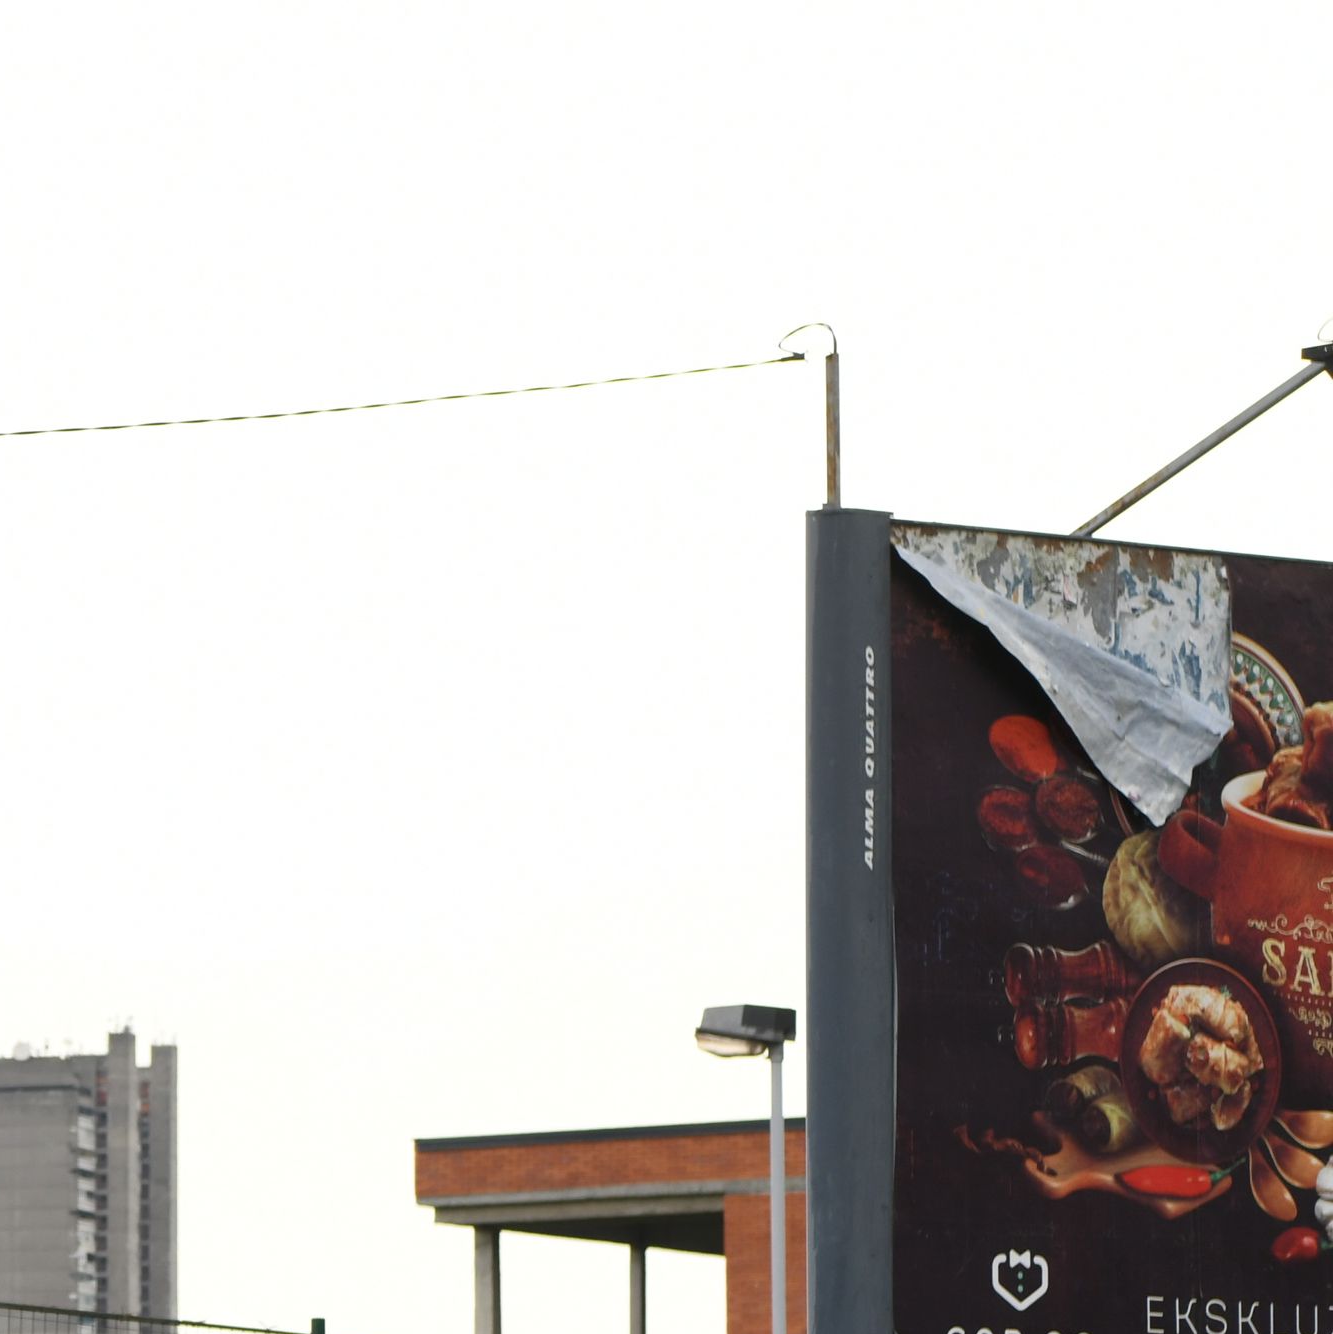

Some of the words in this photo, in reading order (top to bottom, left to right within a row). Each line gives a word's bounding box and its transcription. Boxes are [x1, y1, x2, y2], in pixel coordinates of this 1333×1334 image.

[865, 645, 875, 778] QUATTRO
[864, 789, 874, 870] ALMA
[1262, 937, 1333, 998] SA
